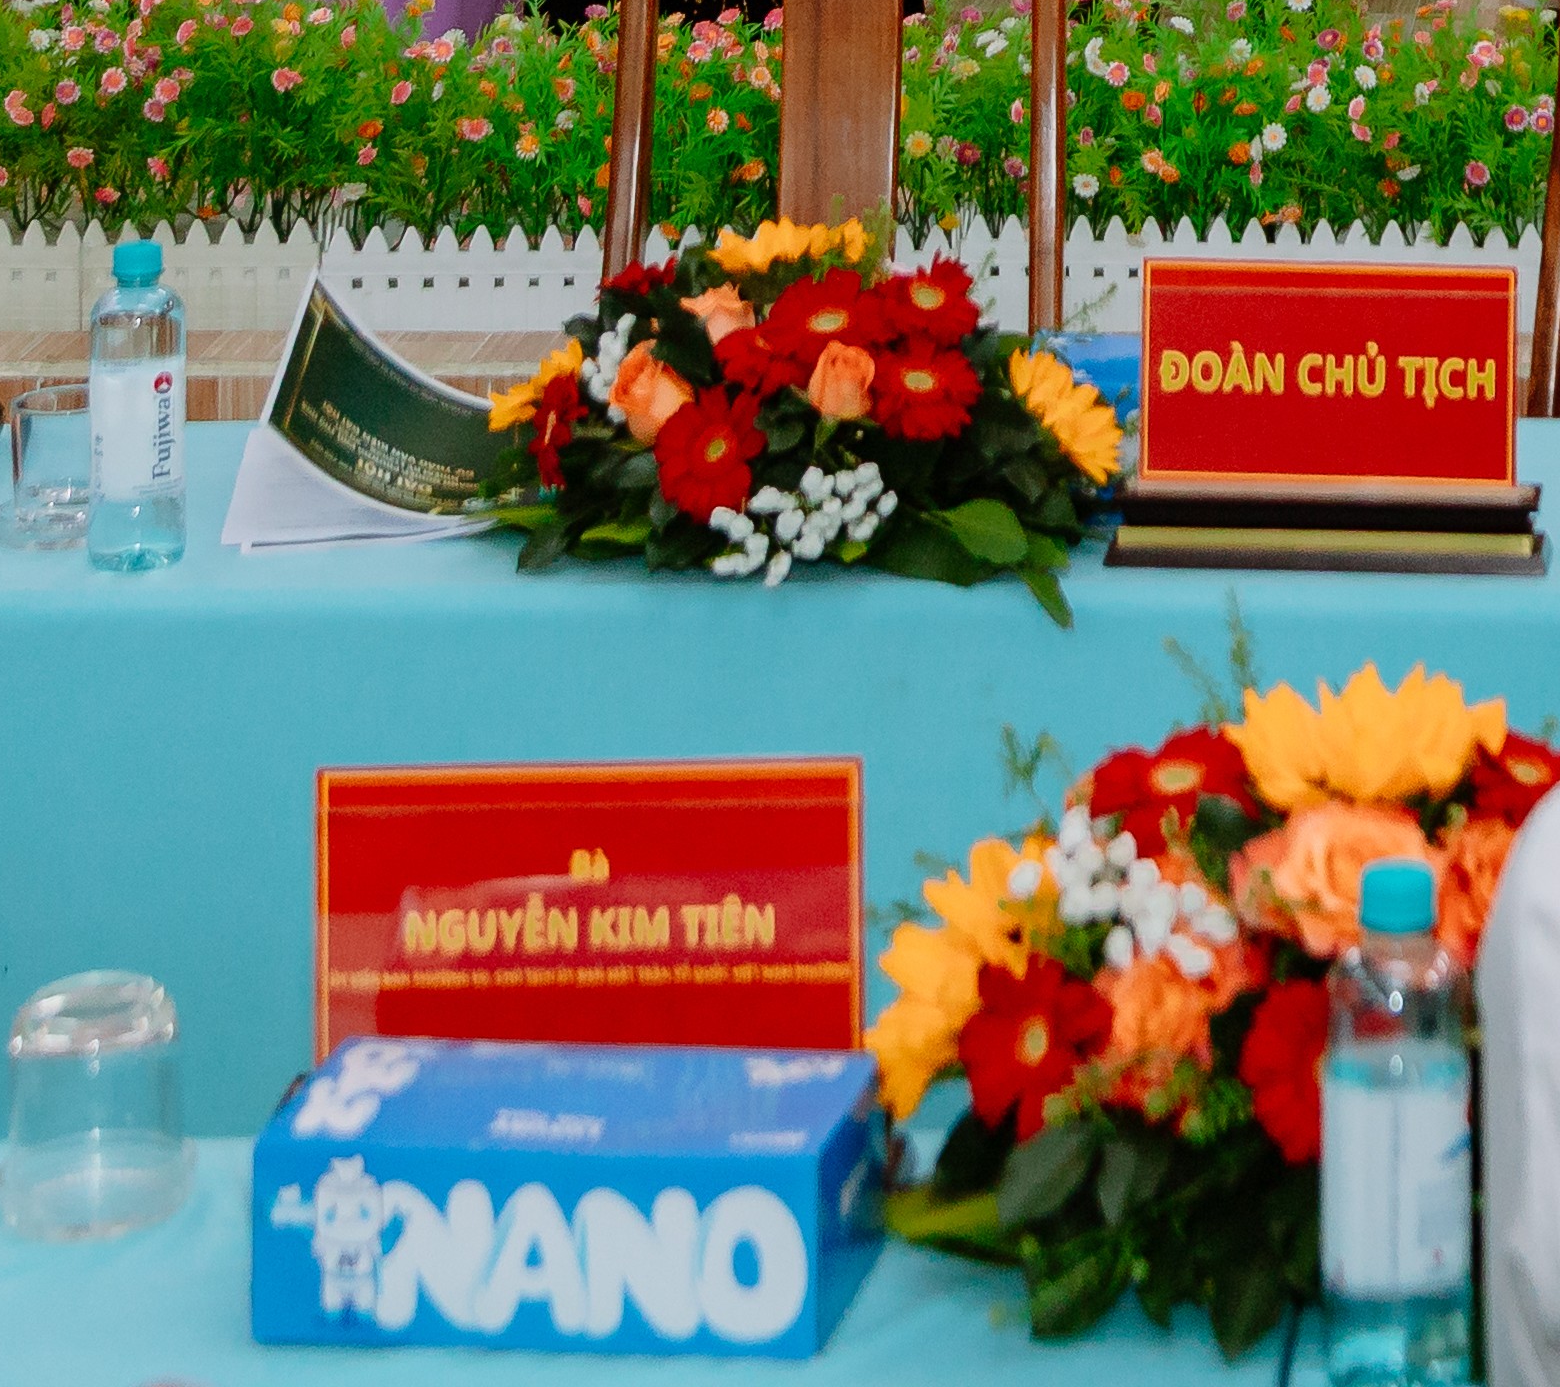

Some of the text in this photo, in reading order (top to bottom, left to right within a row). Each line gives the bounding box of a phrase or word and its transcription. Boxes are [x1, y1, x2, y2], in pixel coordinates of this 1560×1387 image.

[1159, 340, 1497, 410] ĐOÀN CHỦ TỊCH
[151, 395, 177, 481] Fujiwa
[374, 1177, 808, 1345] NANO
